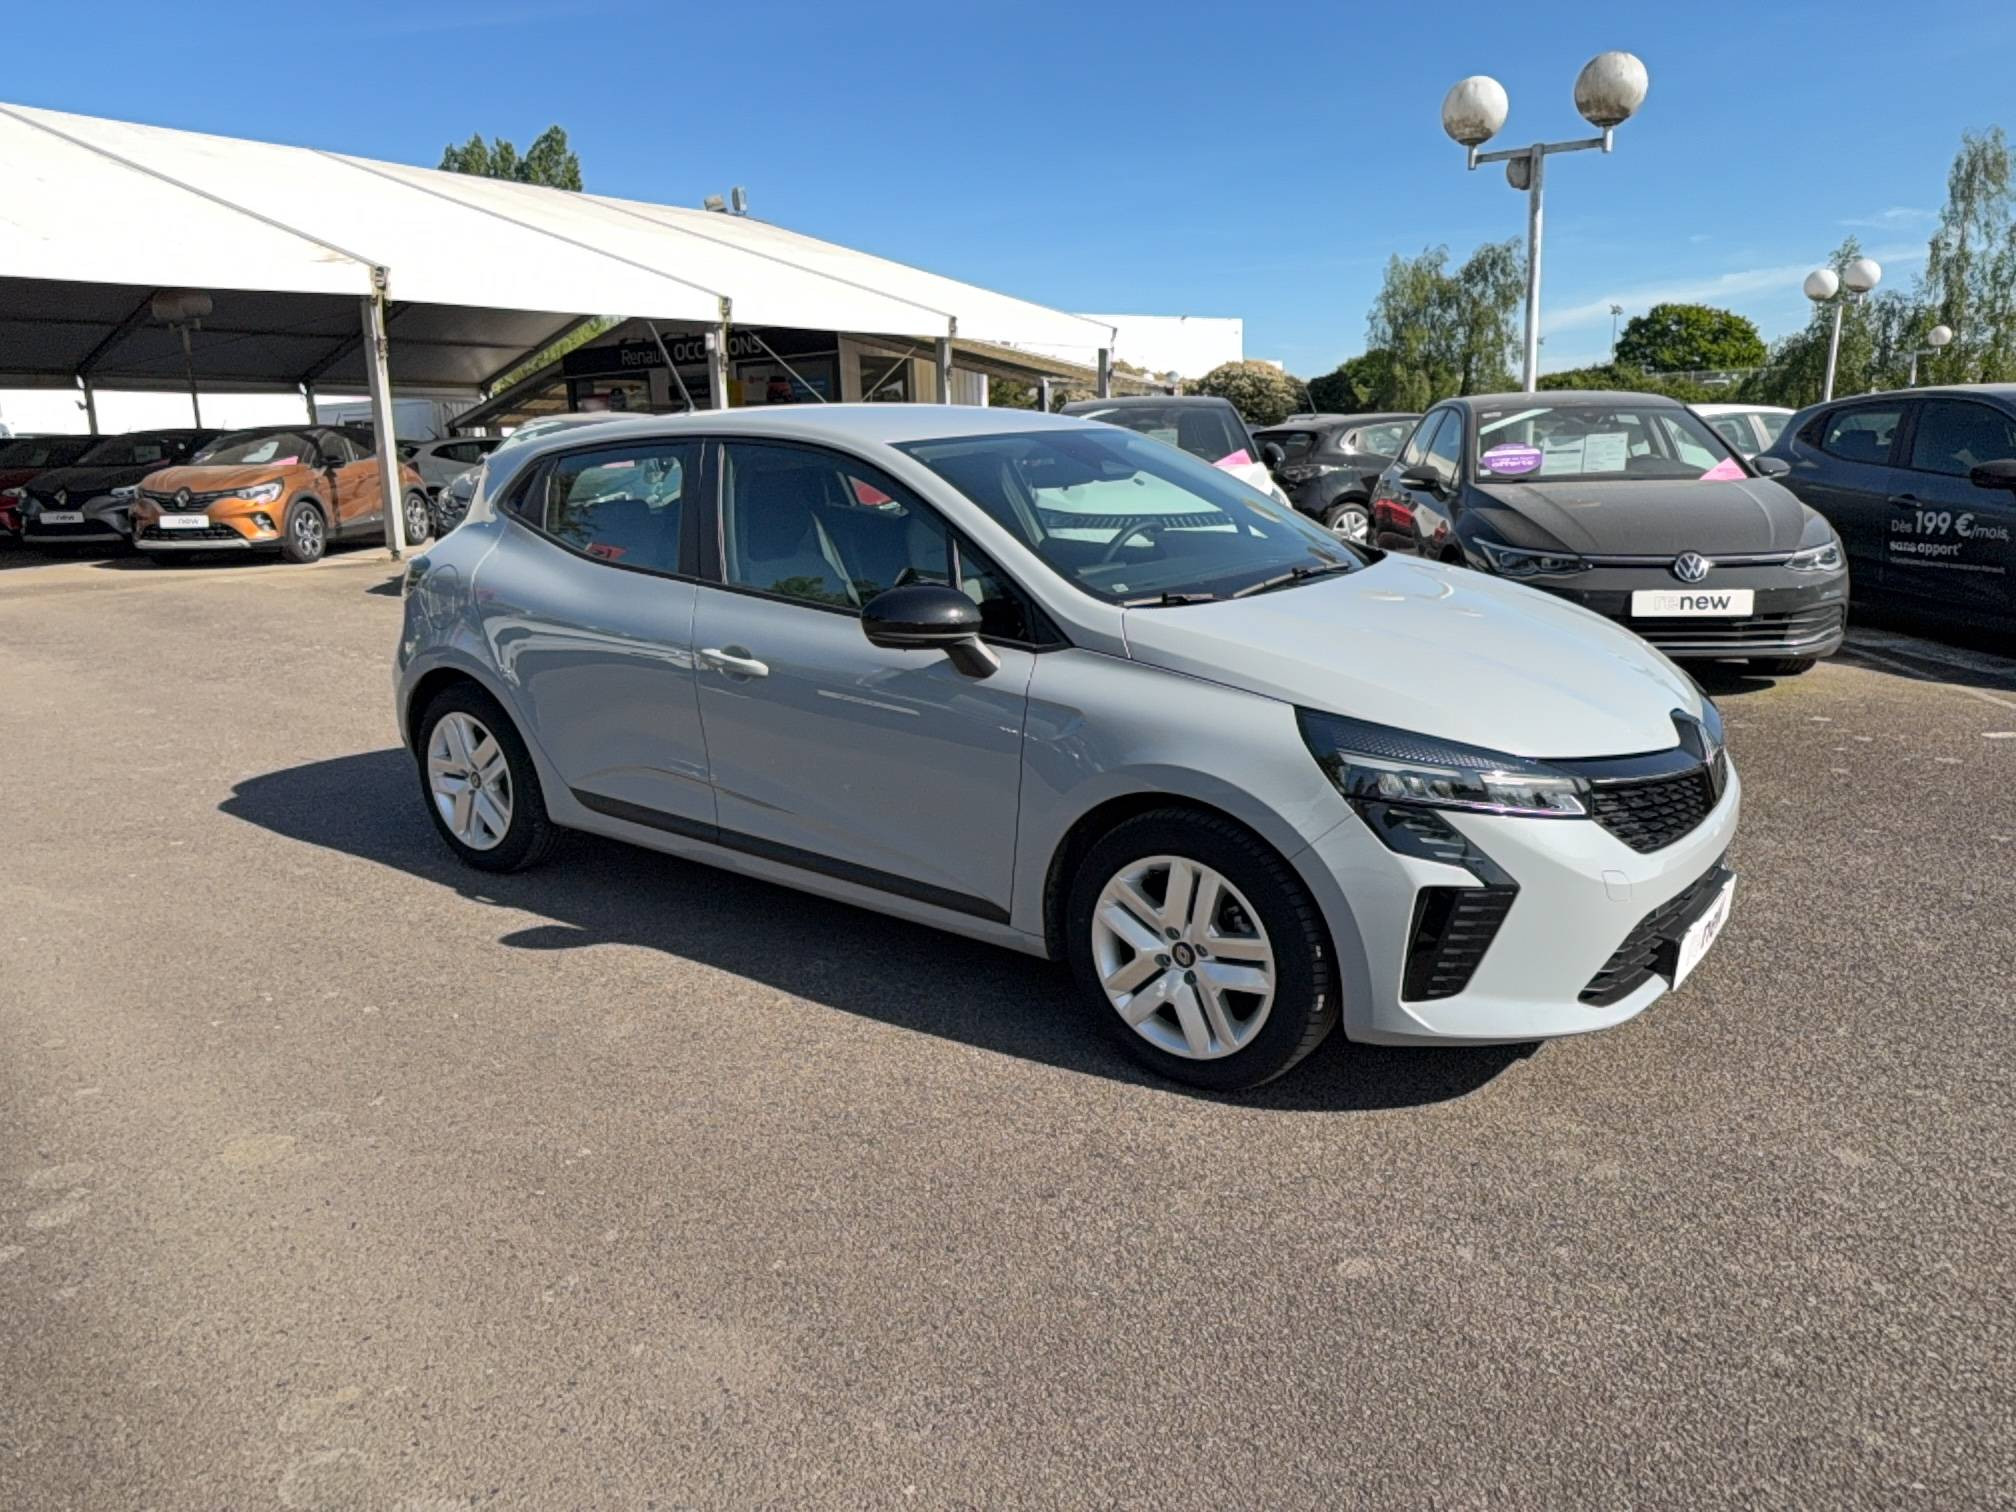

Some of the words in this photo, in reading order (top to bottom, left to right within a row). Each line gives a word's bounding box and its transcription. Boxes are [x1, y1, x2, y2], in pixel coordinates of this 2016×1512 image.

[673, 334, 763, 361] OCCONS
[1891, 519, 1913, 533] Dès
[1915, 510, 1951, 535] 199
[1889, 540, 1917, 553] sans
